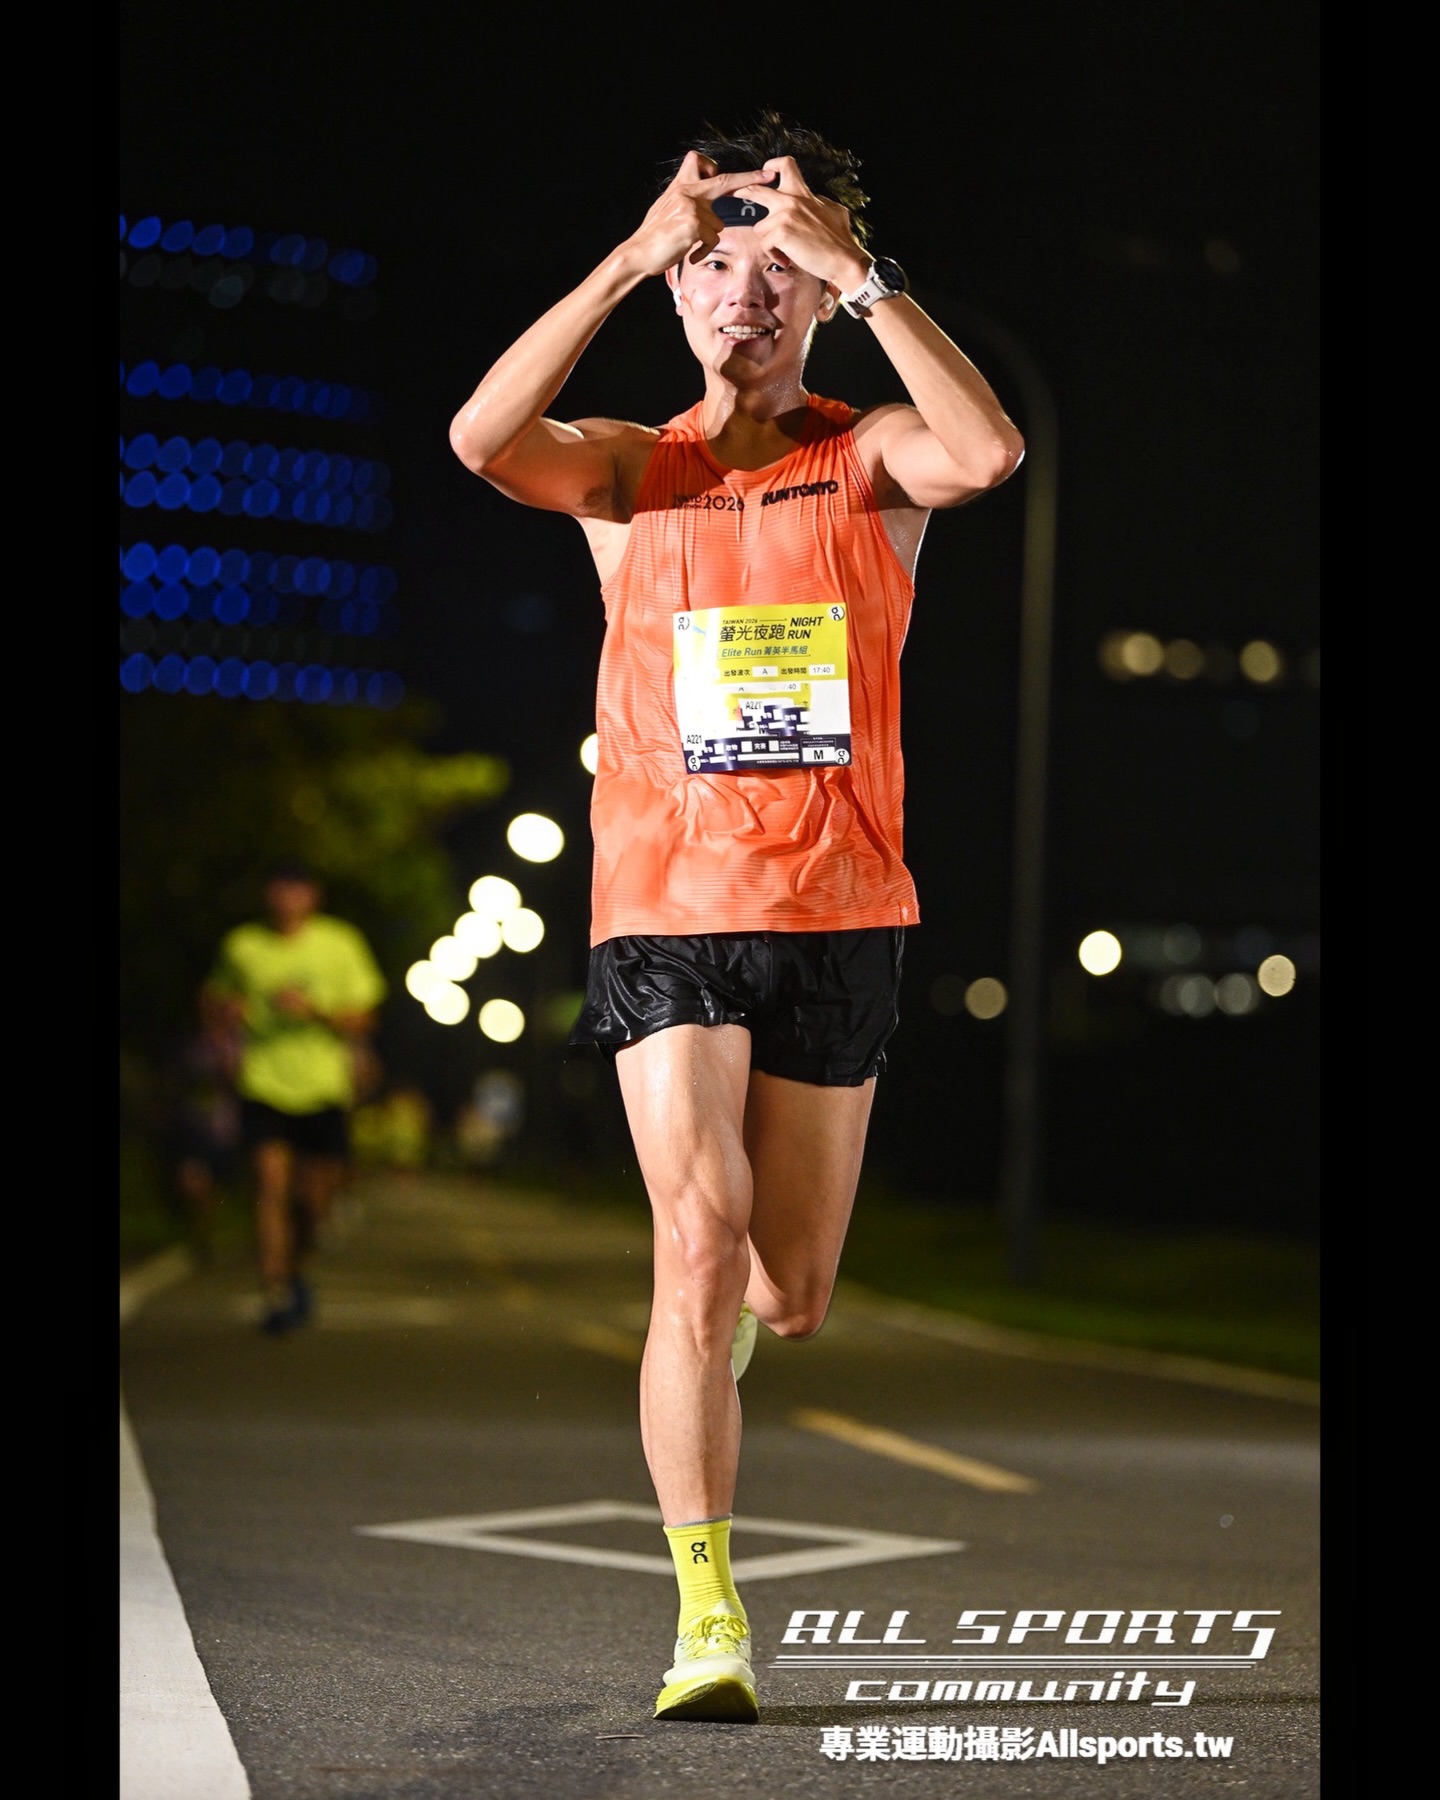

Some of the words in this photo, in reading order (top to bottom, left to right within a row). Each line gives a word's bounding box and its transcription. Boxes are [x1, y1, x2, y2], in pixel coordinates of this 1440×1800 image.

[790, 616, 824, 627] NIGHT
[719, 624, 786, 643] 螢光夜跑
[787, 629, 812, 640] RUN
[721, 647, 742, 658] Elite
[744, 646, 763, 656] Run
[686, 734, 703, 744] A221
[813, 749, 824, 760] M
